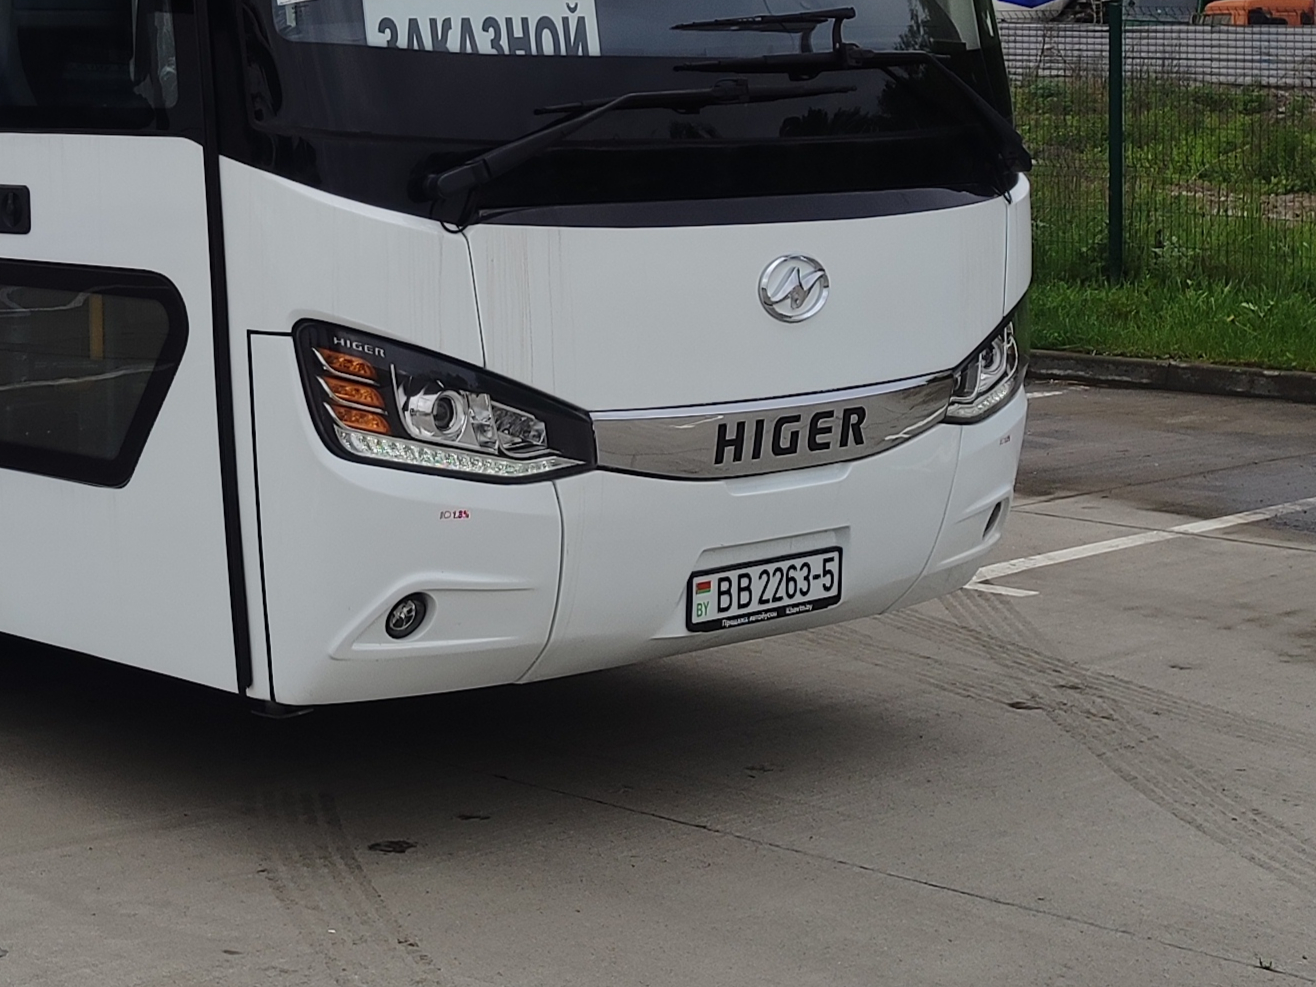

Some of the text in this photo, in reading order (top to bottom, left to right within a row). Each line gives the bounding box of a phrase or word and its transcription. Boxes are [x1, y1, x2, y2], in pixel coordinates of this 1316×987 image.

[378, 2, 589, 56] ЗАКАЗНОЙ
[333, 336, 385, 358] HIGER
[714, 406, 866, 465] HIGER
[696, 601, 710, 617] BY
[717, 556, 835, 613] BB 2263-5
